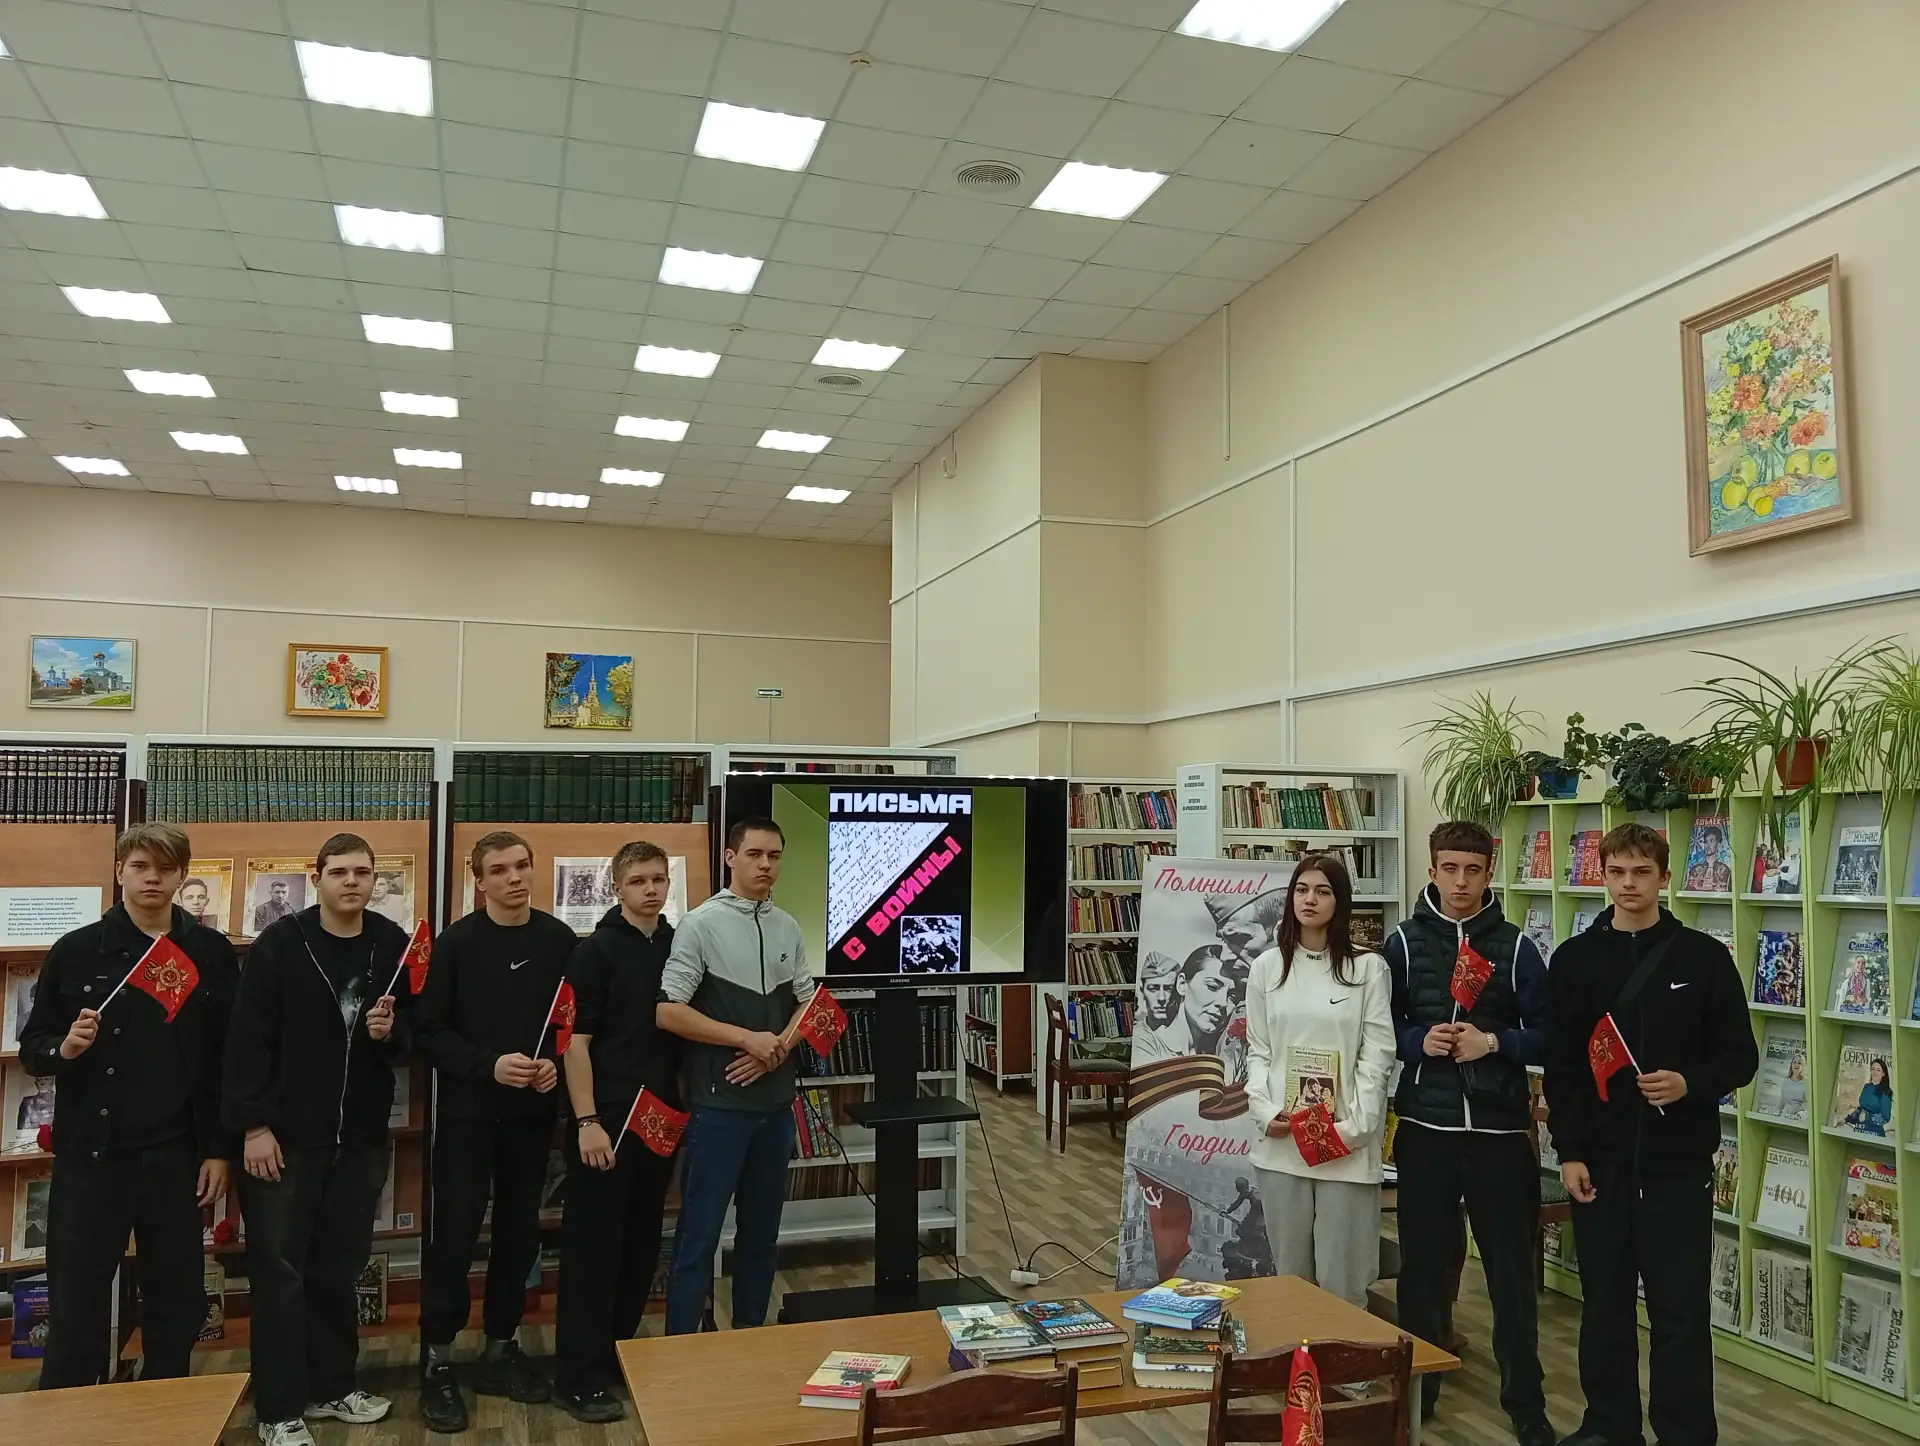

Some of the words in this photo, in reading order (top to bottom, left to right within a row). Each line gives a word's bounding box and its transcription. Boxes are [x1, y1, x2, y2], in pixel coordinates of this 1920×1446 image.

[829, 792, 972, 815] ПИСЬМА
[1153, 868, 1268, 896] Помним!
[842, 936, 867, 961] С
[866, 836, 962, 936] ВОЙНЫ
[1768, 1152, 1808, 1168] ТАТАРСТА
